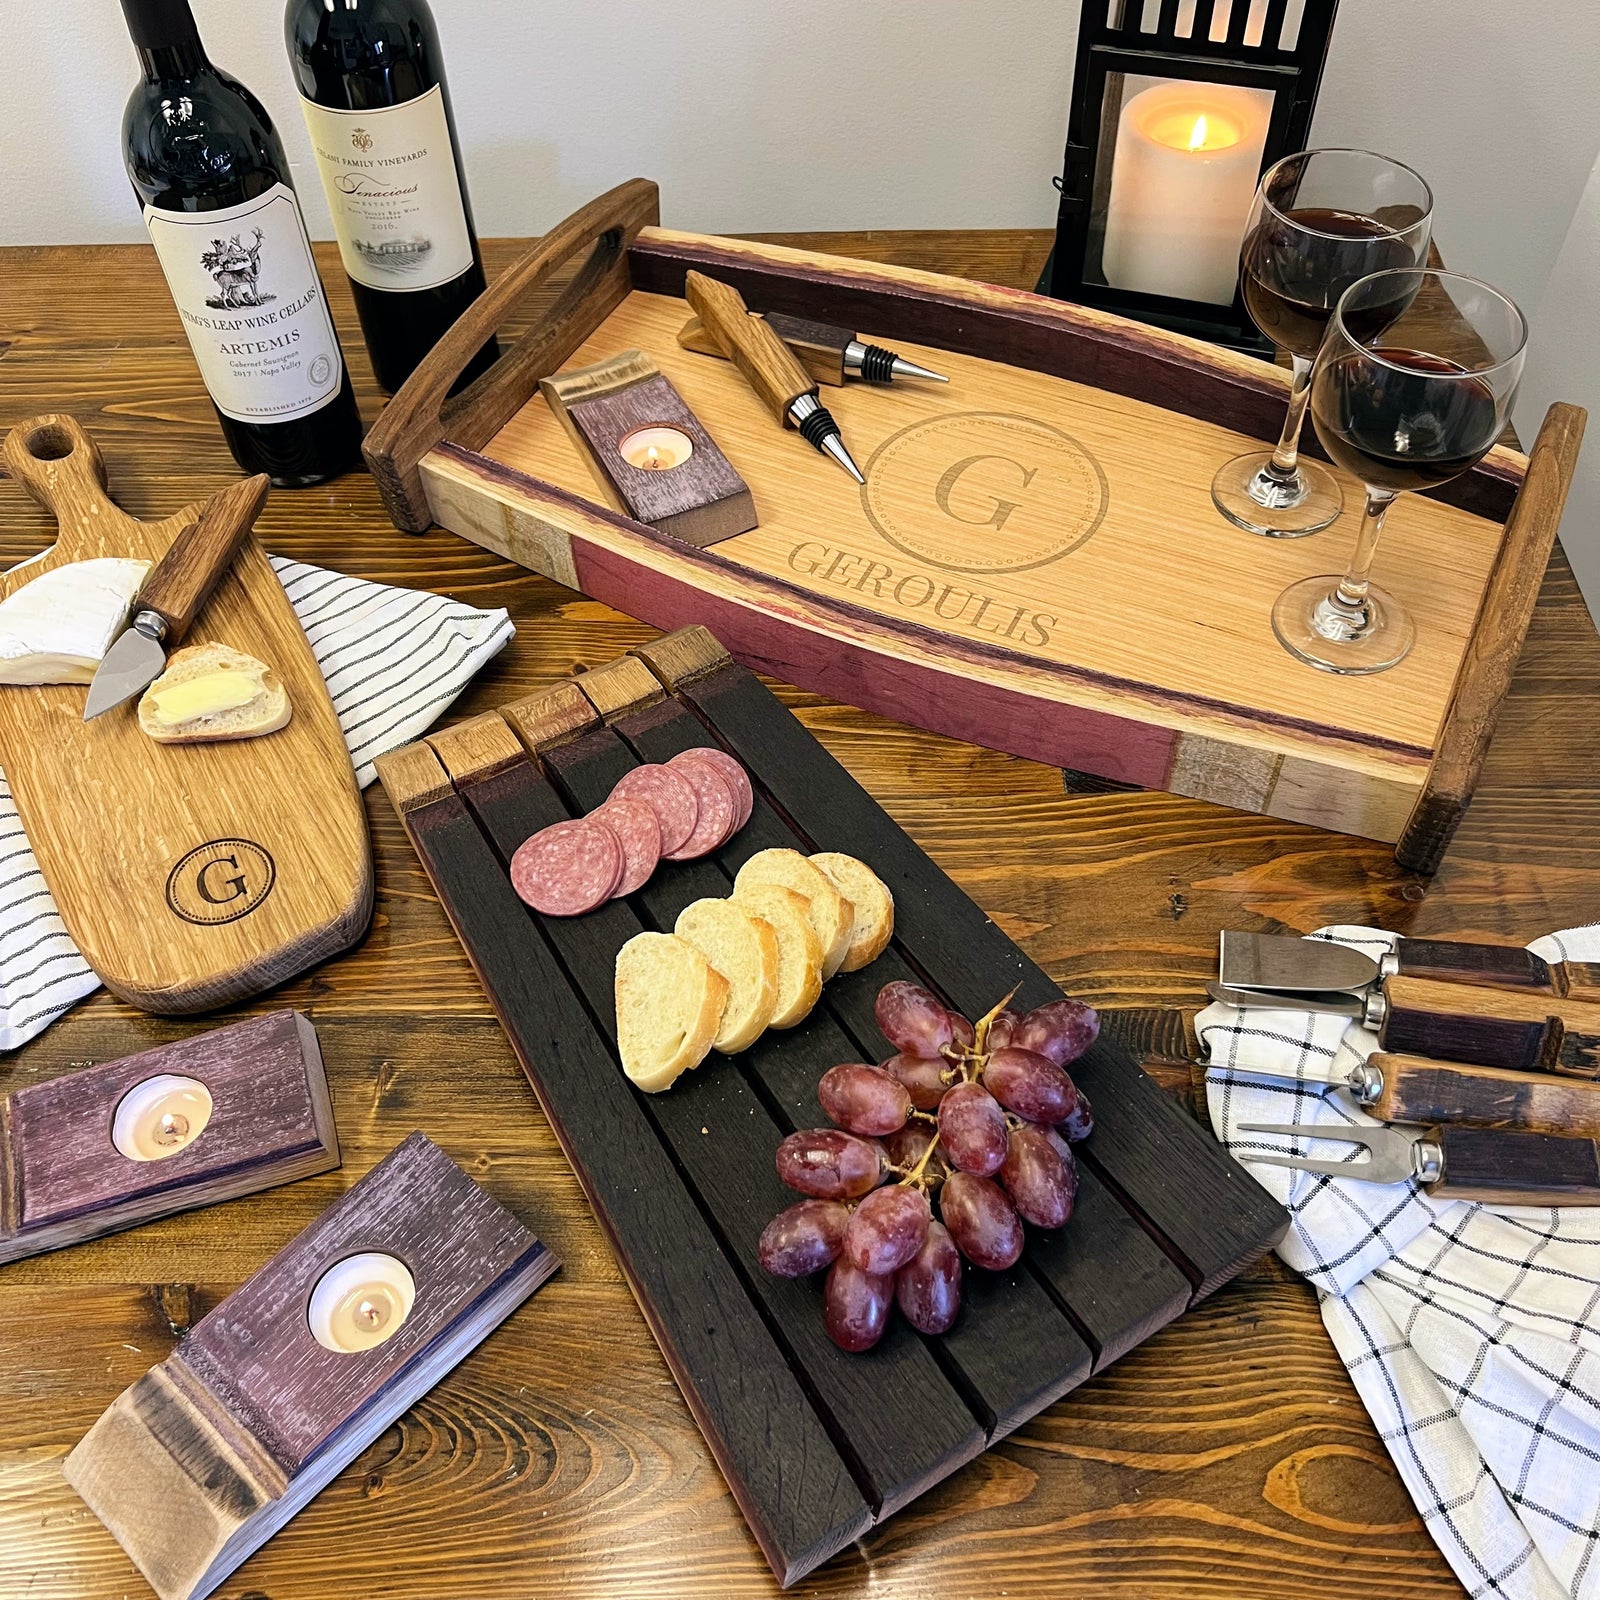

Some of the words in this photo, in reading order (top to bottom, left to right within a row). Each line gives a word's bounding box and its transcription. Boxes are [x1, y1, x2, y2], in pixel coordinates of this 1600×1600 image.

[342, 158, 374, 168] FAMILY
[377, 148, 428, 167] VINEYARDS
[334, 172, 418, 197] Tenacious
[212, 319, 242, 331] LEAP
[244, 312, 278, 330] WINE
[279, 286, 316, 320] CELLARS
[220, 329, 300, 354] ARTEMIS
[229, 360, 262, 368] Cabernet
[263, 350, 299, 366] Sauvignon
[232, 370, 252, 378] 2017
[260, 368, 280, 377] Napa
[280, 360, 301, 371] Valley
[935, 455, 1038, 531] G
[787, 541, 1059, 647] GEROULIS
[196, 854, 248, 904] G
